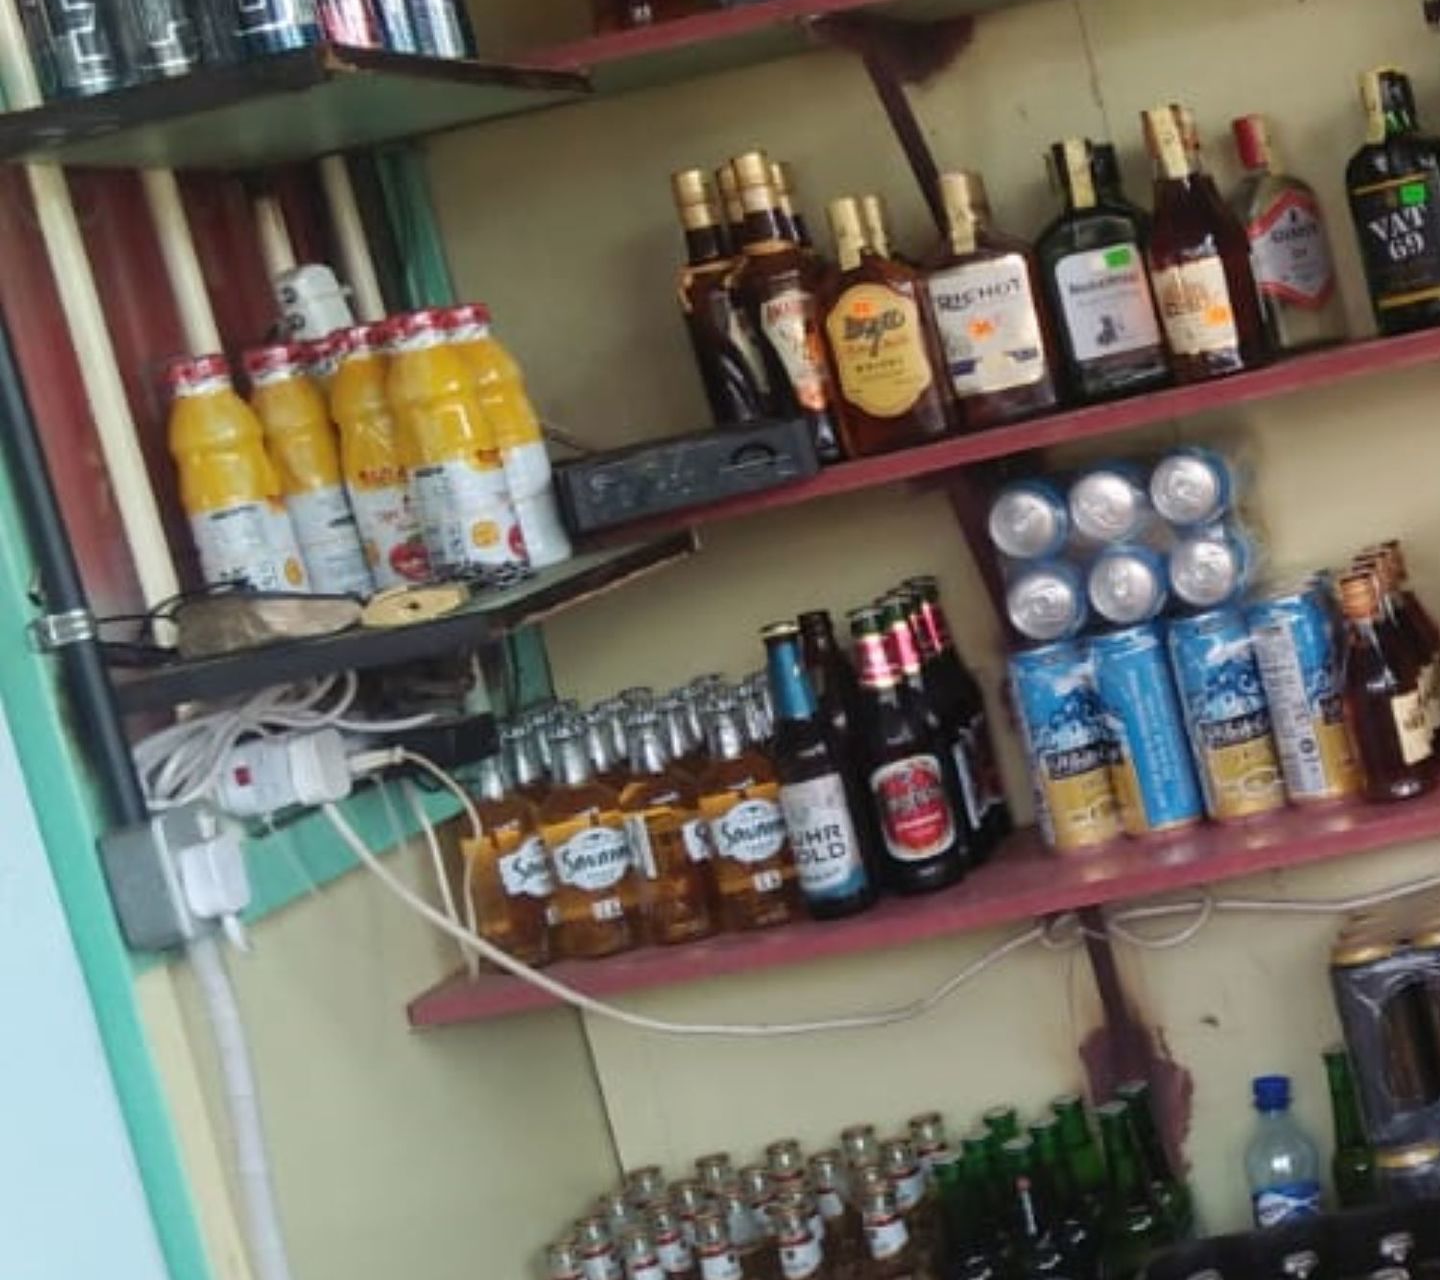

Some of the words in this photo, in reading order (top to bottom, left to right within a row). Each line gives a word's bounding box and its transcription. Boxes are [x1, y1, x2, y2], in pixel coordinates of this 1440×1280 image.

[1367, 204, 1427, 241] VAT
[1389, 230, 1426, 261] 69
[937, 277, 1021, 312] RICHOT
[719, 812, 787, 844] Savann
[560, 828, 633, 870] Savann
